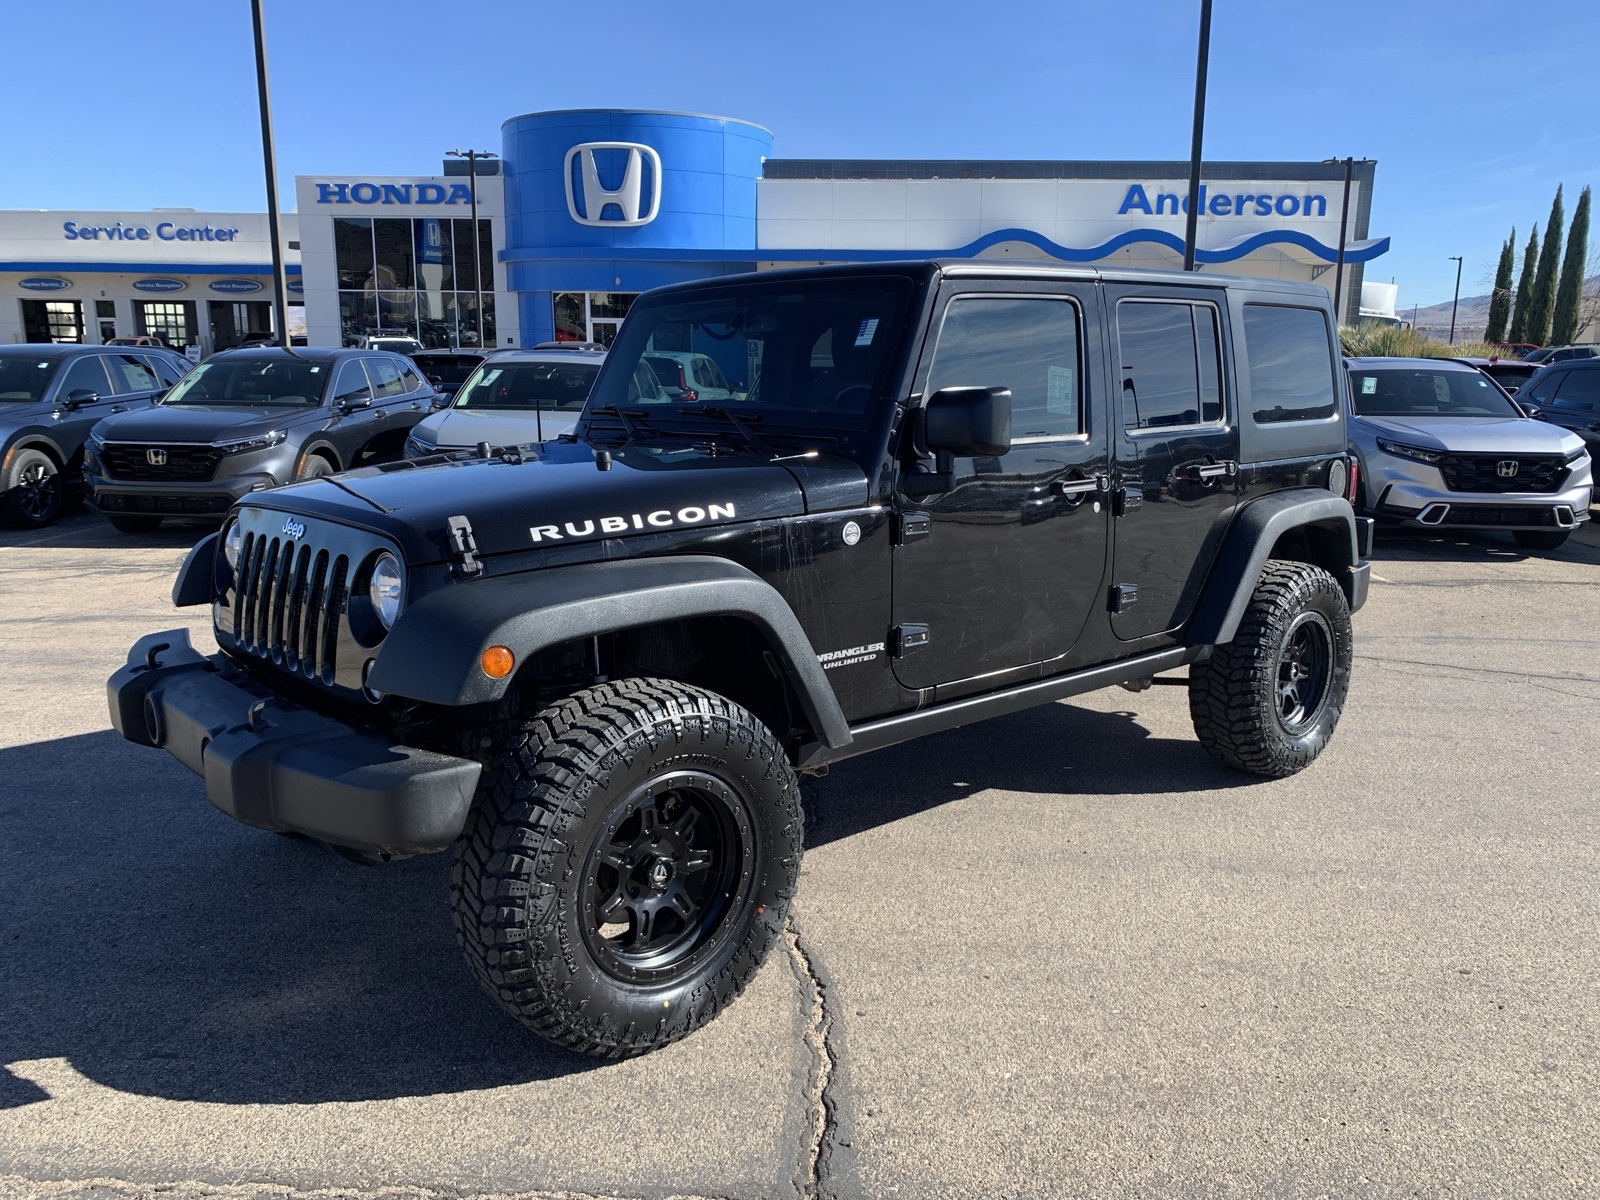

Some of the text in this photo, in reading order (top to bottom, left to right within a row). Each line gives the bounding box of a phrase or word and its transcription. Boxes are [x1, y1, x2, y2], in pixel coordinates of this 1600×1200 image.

[315, 183, 481, 204] HONDA
[1117, 184, 1327, 217] Anderson
[63, 221, 239, 241] Service Center
[282, 517, 305, 540] Jeep
[529, 502, 736, 542] RUBICON
[823, 653, 877, 669] UNLIMITED
